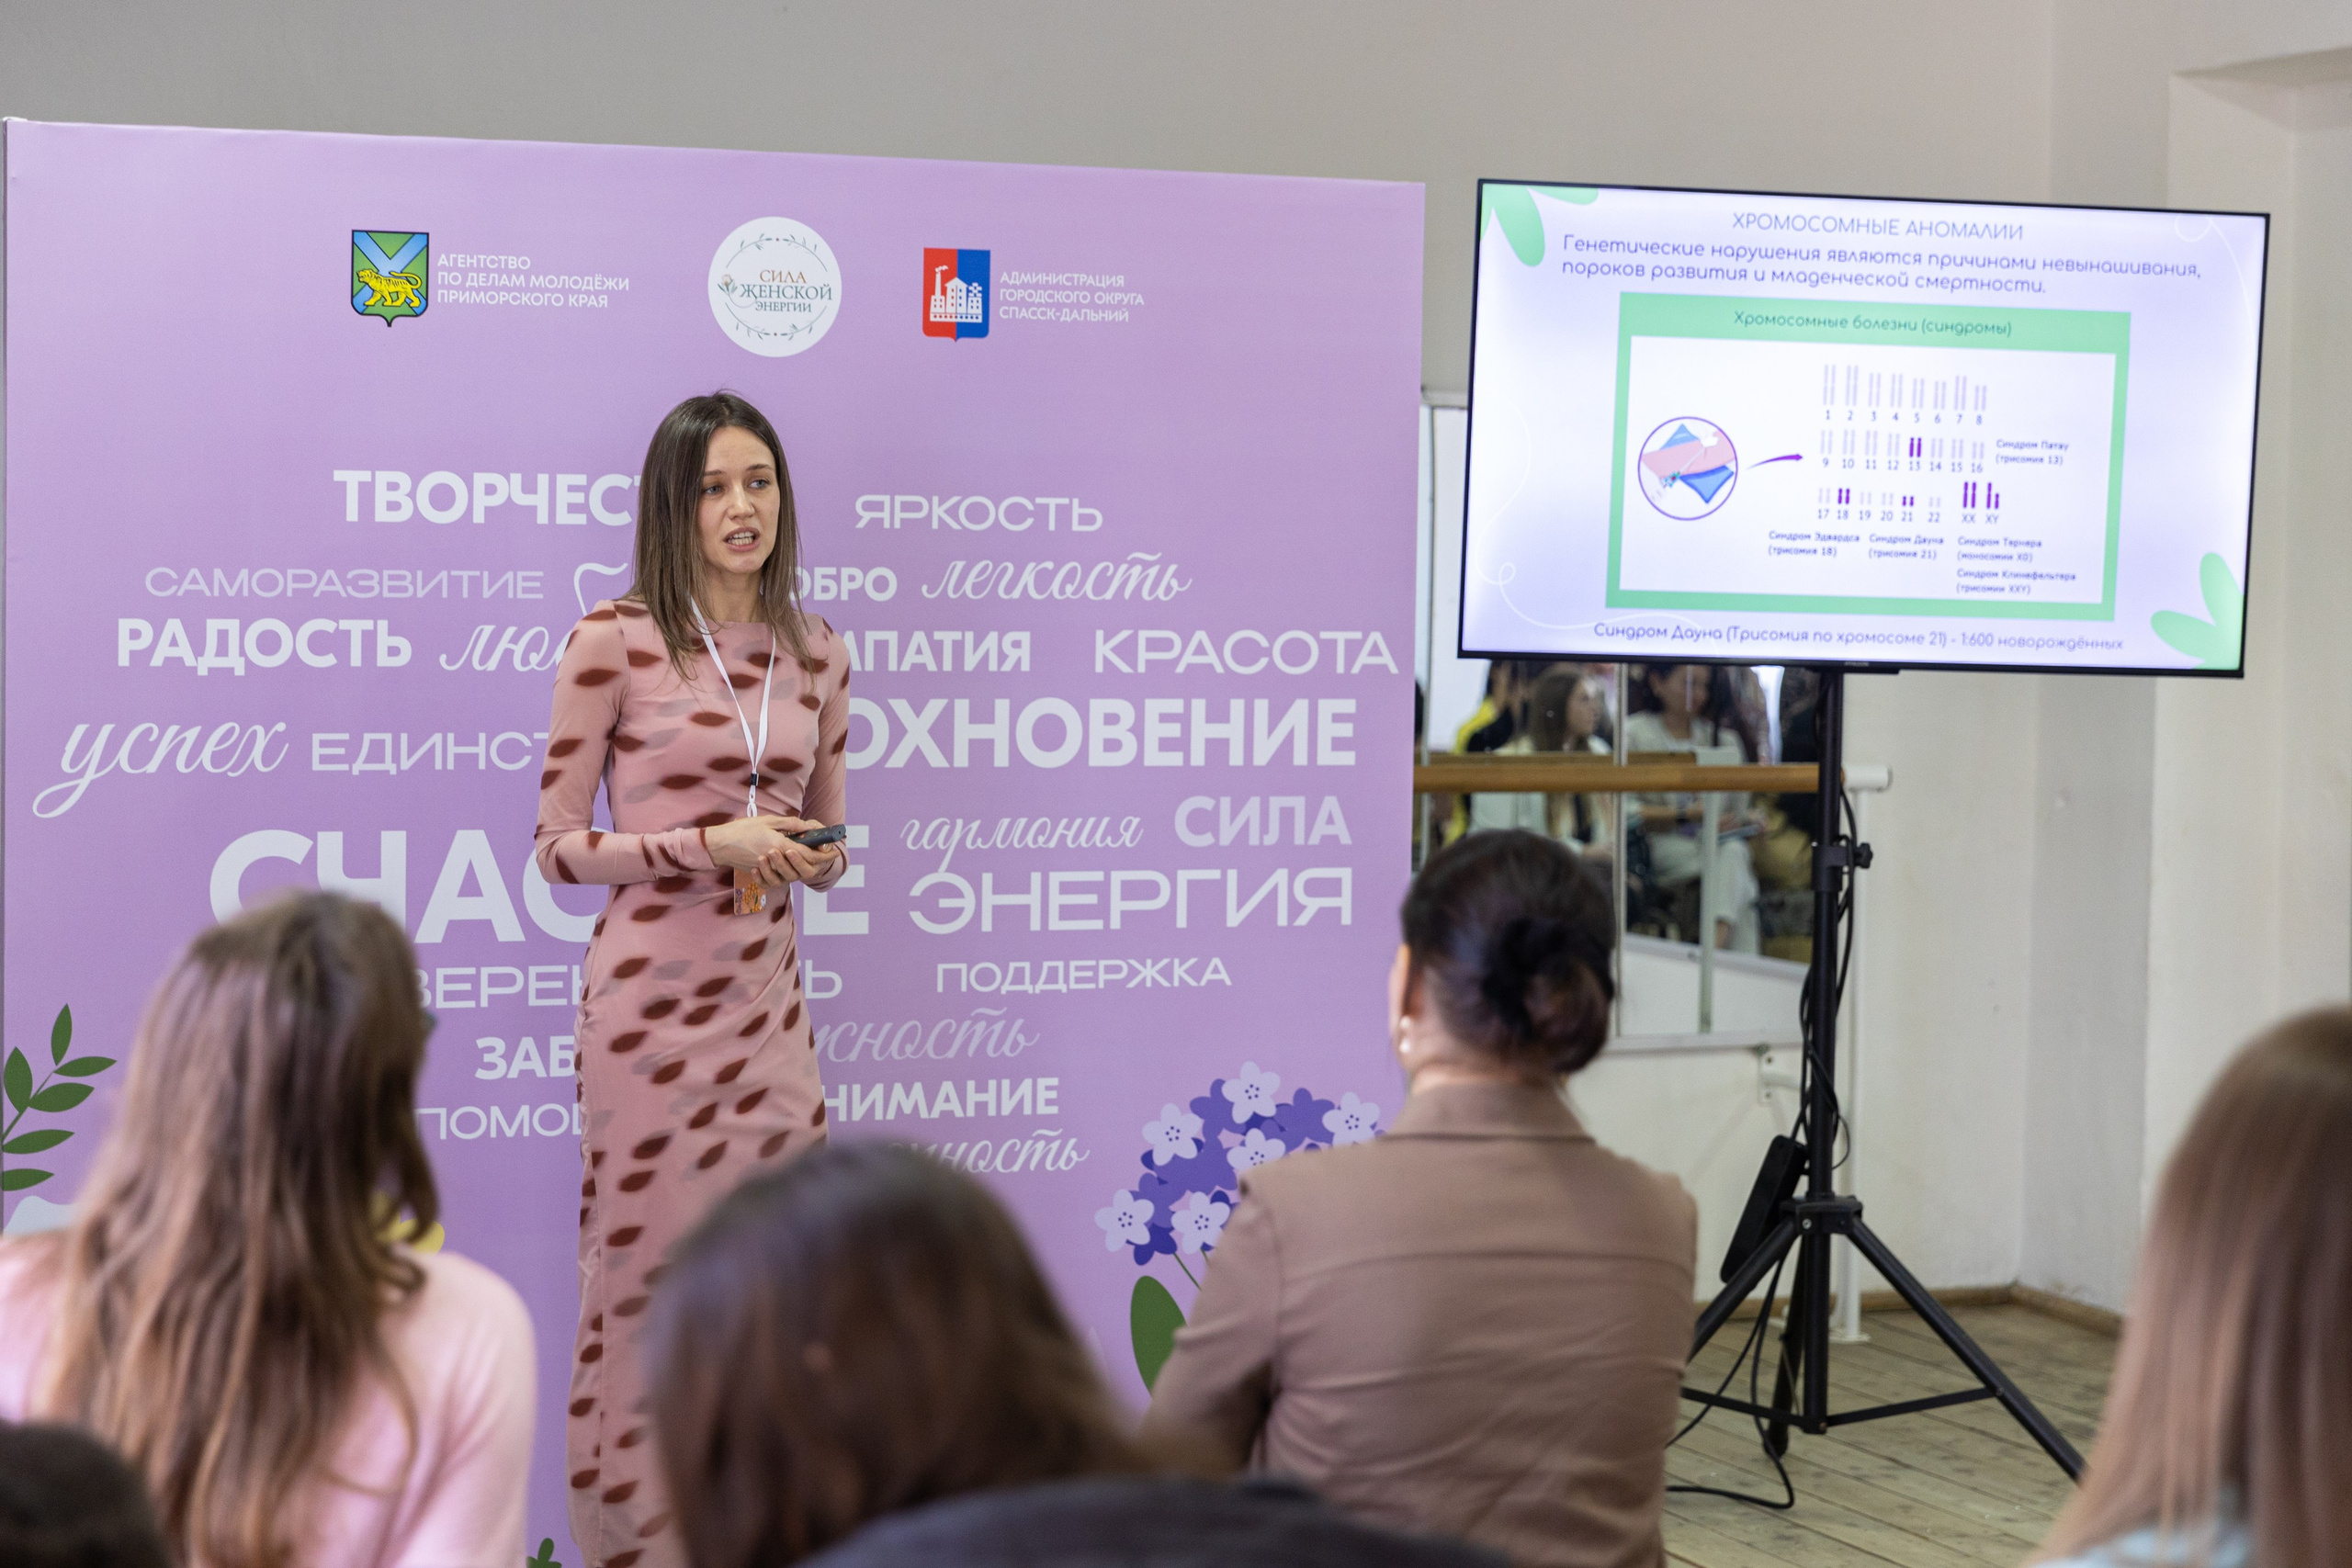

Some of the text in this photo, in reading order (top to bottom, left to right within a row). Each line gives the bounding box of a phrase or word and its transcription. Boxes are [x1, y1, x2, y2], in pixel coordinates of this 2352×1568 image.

[1732, 212, 2023, 240] ХРОМОСОМНЫЕ АНОМАЛИИ
[437, 254, 531, 270] АГЕНТСТВО
[1564, 234, 2200, 278] Генетические нарушения являются причинами невынашивания,
[437, 272, 629, 291] ПО ДЕЛАМ МОЛОДЁЖИ
[759, 269, 807, 284] СИЛА
[1000, 272, 1125, 288] АДМИНИСТРАЦИЯ
[1562, 260, 2046, 294] пороков развития и младенческой смертности.
[437, 289, 608, 308] ПРИМОРСКОГО КРАЯ
[740, 283, 832, 300] ЖЕНСКОЙ
[1000, 288, 1145, 306] ГОРОДСКОГО ОКРУГА
[755, 300, 812, 313] ЭНЕРГИИ
[999, 306, 1129, 322] СПАССК-ДАЛЬНИЙ
[1734, 310, 2012, 338] Хромосомные болезни (синдромы)
[1825, 410, 1984, 426] 1 2 3 4 5 6 7 8
[1996, 439, 2038, 451] Синдром
[1822, 457, 1984, 474] 9 10 11 12 13 14 15 16
[334, 469, 641, 526] ТВОРЧЕС
[854, 494, 1103, 532] ЯРКОСТЬ
[1817, 508, 1830, 521] 17
[1836, 509, 1849, 521] 18
[1859, 510, 1871, 522] 19
[1880, 510, 1894, 523] 20
[1901, 511, 1914, 523] 21
[1927, 512, 1941, 524] 22
[1770, 530, 1811, 543] Синдром
[1870, 534, 1911, 546] Синдром
[1958, 536, 1999, 548] Синдром
[145, 567, 544, 599] САМОРАЗВИТИЕ
[787, 566, 898, 603] ОБРО
[922, 551, 1193, 602] легкость
[1957, 569, 1998, 581] Синдром
[117, 618, 413, 676] РАДОСТЬ
[1594, 622, 1668, 641] Синдром
[1671, 625, 1723, 642] Дауна
[1726, 625, 1808, 643] (Трисомия
[1813, 630, 1832, 643] по
[1837, 631, 1925, 645] хромосоме
[1928, 630, 1947, 649] 21)
[1997, 635, 2123, 651] новорождённых
[1095, 629, 1398, 674] КРАСОТА
[845, 697, 1357, 770] ОХНОВЕНИЕ
[311, 732, 549, 775] ЕДИНС
[32, 721, 288, 819] успех
[1174, 795, 1352, 847] СИЛА
[900, 814, 1143, 873] гармония
[909, 866, 1353, 935] ЭНЕРГИЯ
[936, 957, 1232, 995] ПОДДЕРЖКА
[475, 1035, 575, 1080] ЗАБ
[821, 1077, 1059, 1122] НИМАНИЕ
[416, 1103, 582, 1140] ПОМО
